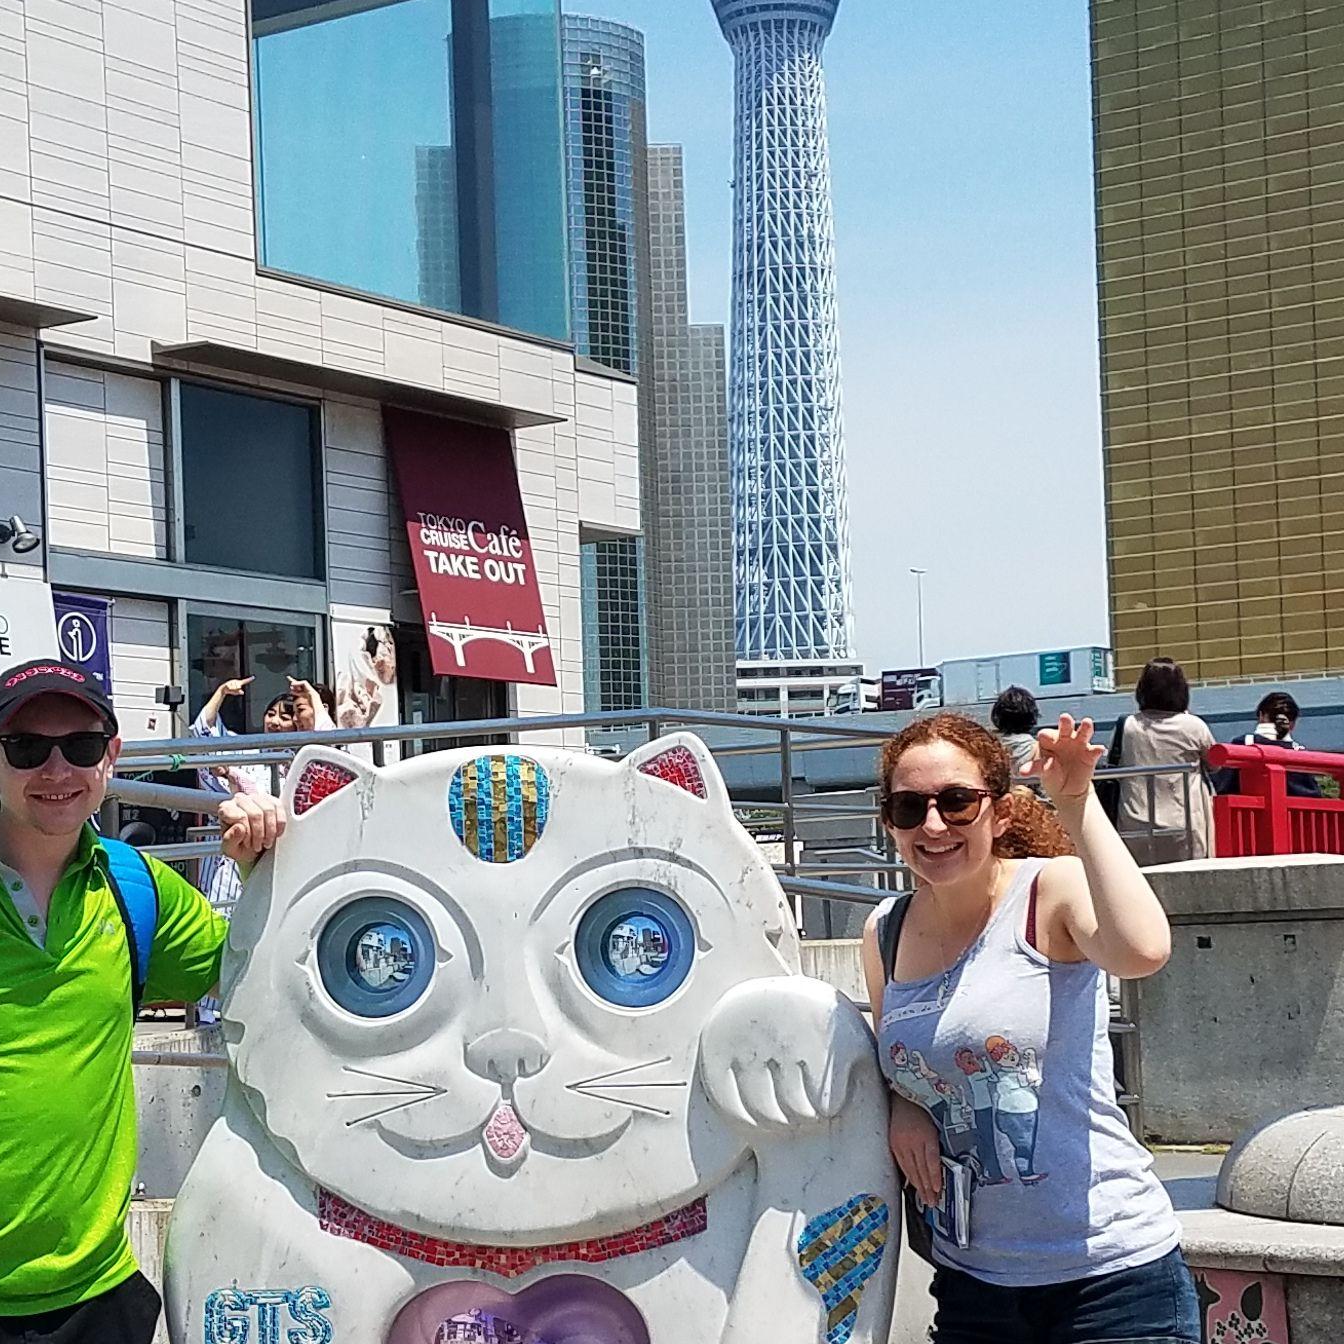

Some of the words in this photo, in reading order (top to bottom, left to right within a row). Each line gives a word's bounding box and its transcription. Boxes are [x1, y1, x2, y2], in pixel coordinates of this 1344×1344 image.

[416, 512, 466, 533] TOKYO
[419, 527, 470, 550] CRUISE
[467, 520, 523, 558] Café
[423, 549, 482, 580] TAKE
[483, 558, 526, 585] OUT
